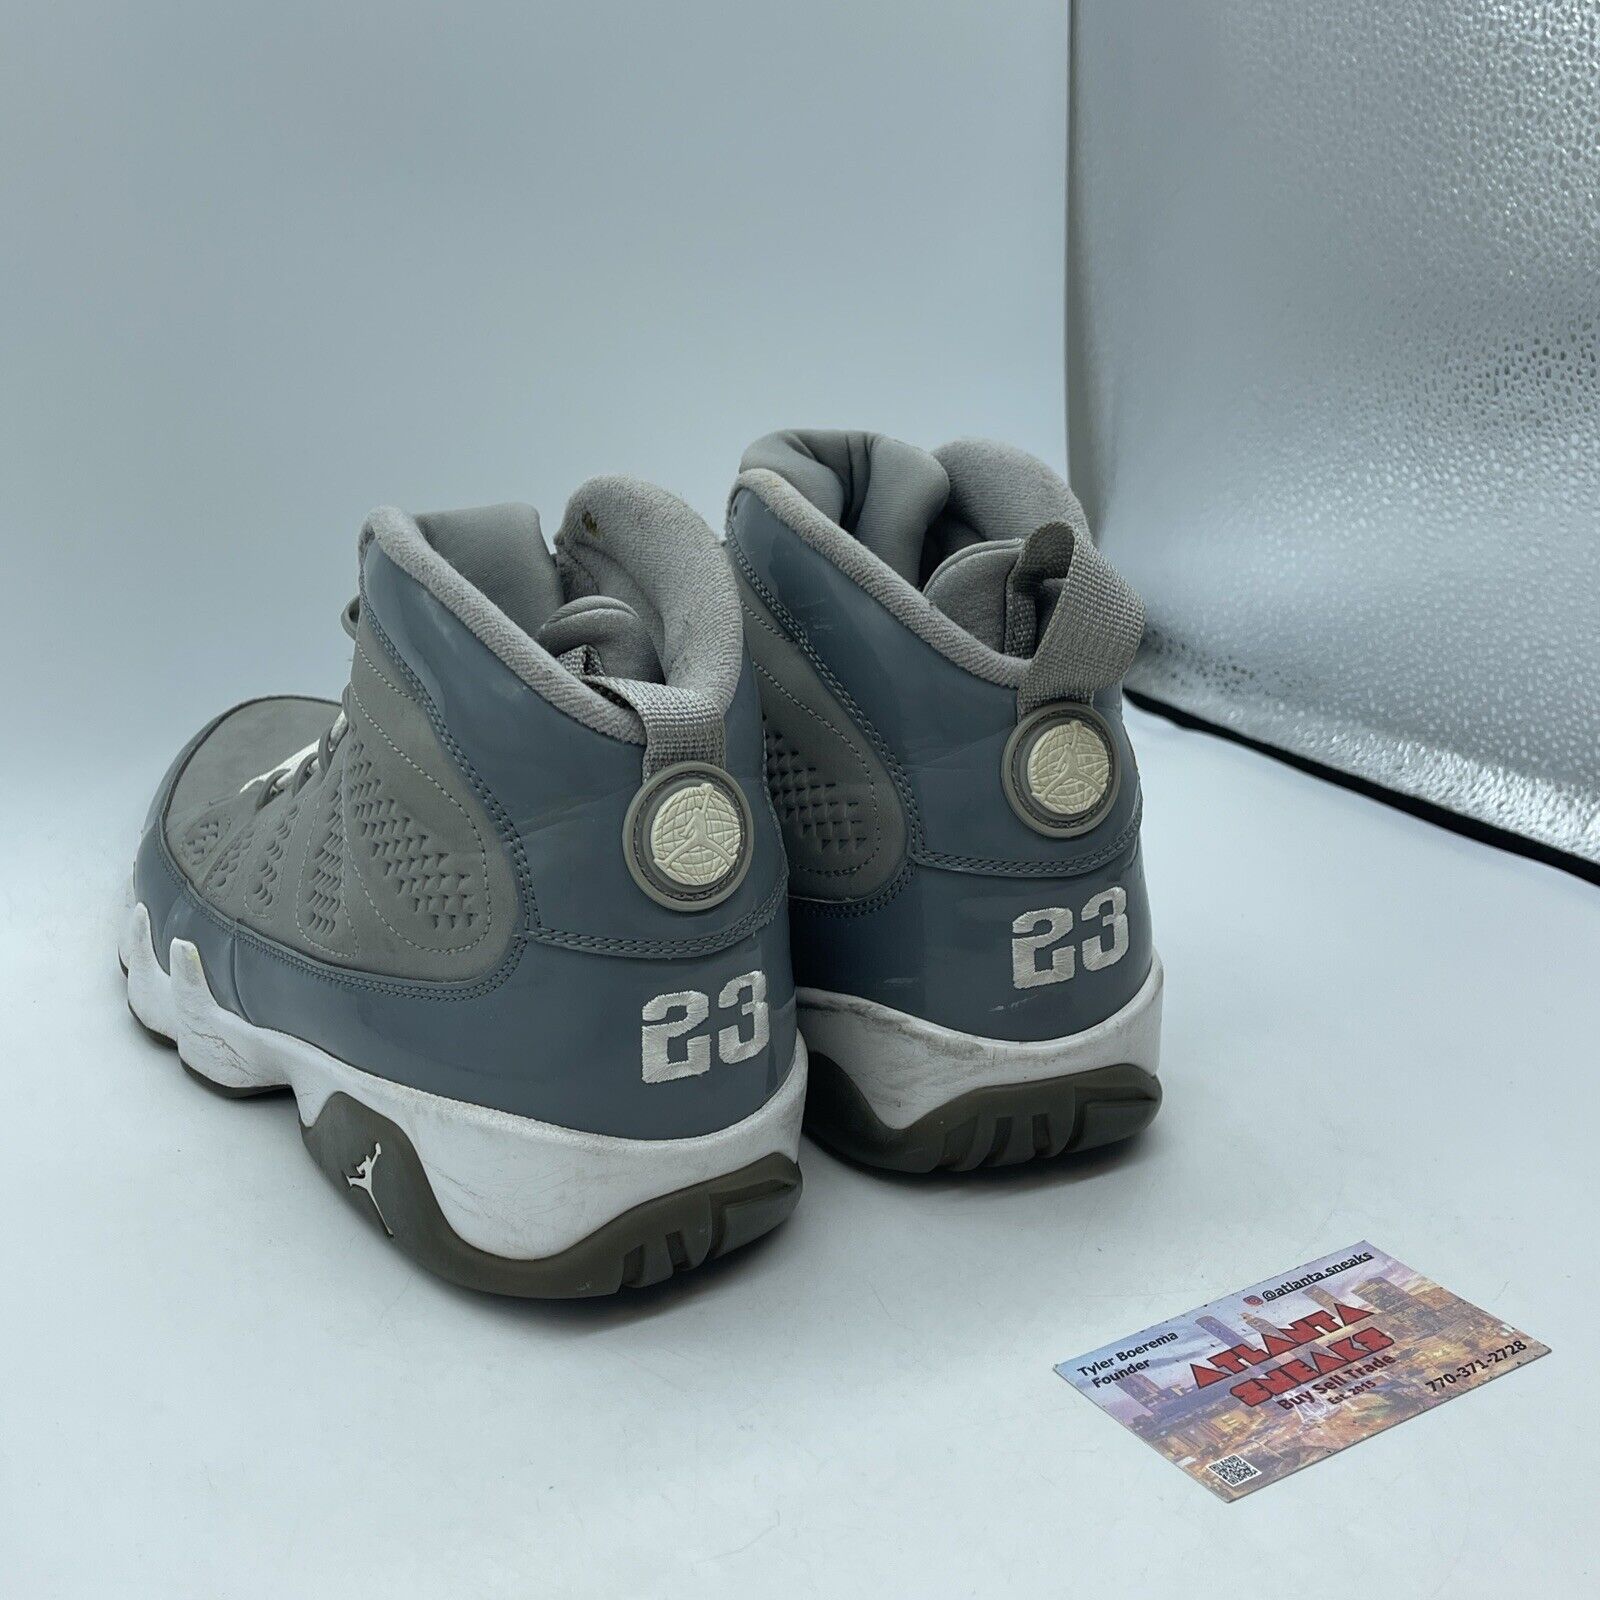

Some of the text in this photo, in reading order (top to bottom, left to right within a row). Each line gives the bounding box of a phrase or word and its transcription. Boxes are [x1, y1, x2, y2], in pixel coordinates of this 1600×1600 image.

[1012, 886, 1129, 989] 23
[642, 970, 769, 1083] 23
[1262, 1252, 1375, 1302] @atlanta.sneaks
[1077, 1332, 1179, 1377] Tyler Boerema
[1188, 1302, 1375, 1389] ATLANTA
[1229, 1326, 1395, 1408] SNEAKS
[1425, 1340, 1527, 1392] 770-371-2728
[1091, 1359, 1151, 1388] Founder
[1277, 1354, 1395, 1410] Buy Sell Trade
[1327, 1379, 1377, 1405] Est. 2015
